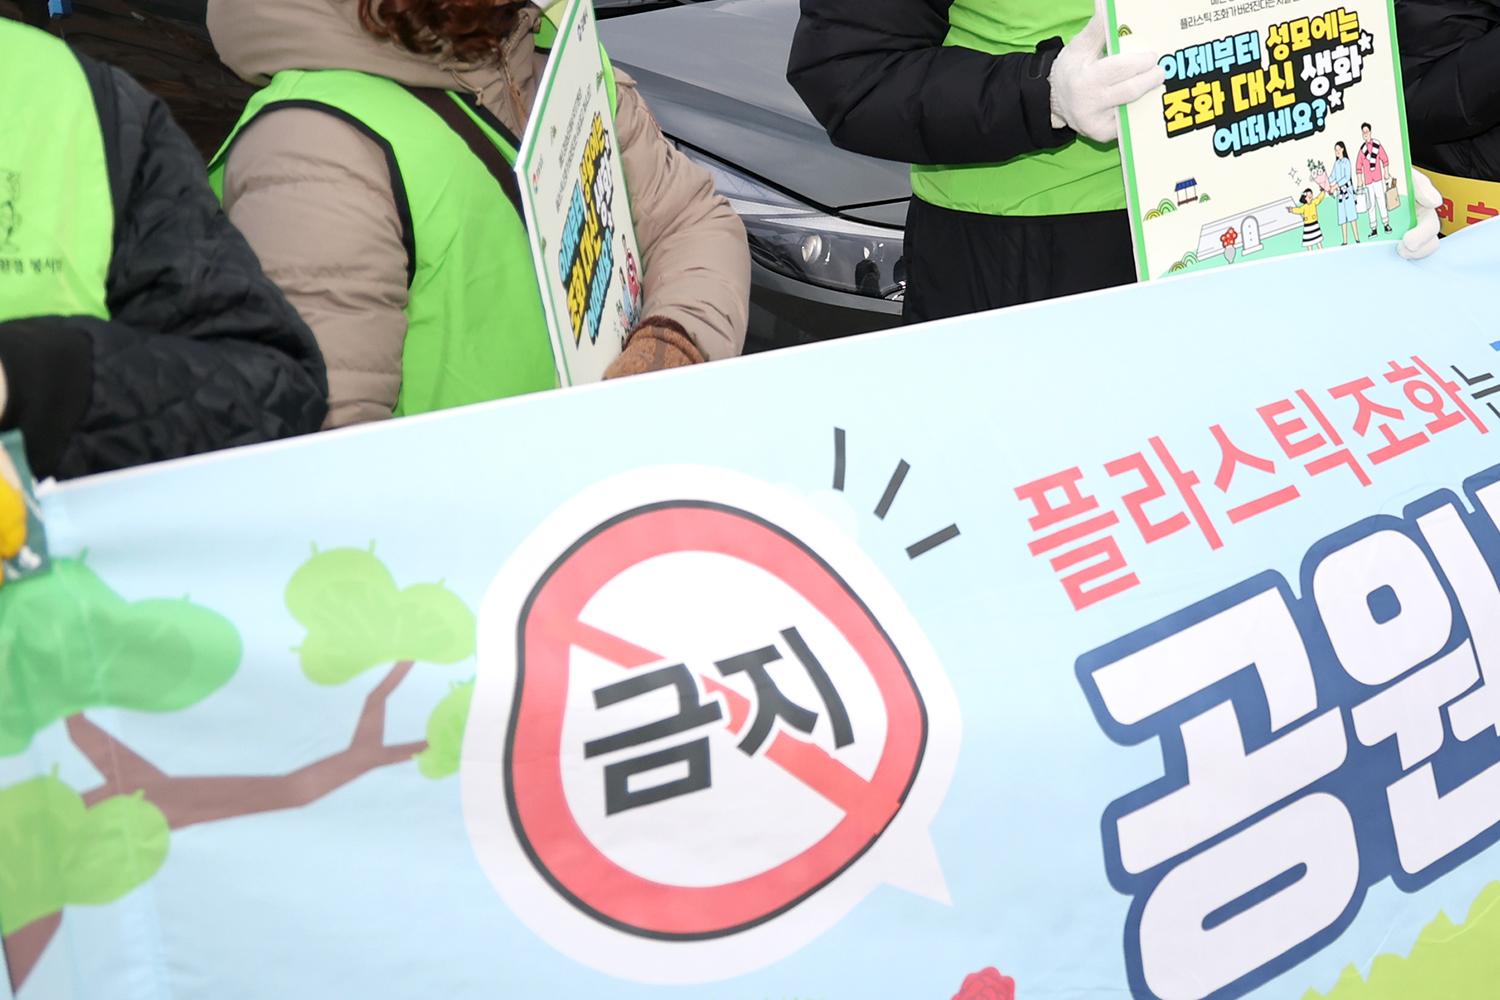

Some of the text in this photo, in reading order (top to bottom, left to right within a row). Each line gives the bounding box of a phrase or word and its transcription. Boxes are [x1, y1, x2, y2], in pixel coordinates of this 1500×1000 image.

[1157, 6, 1361, 82] 이제부터 성묘에는
[1179, 11, 1213, 30] 플라스틱
[1213, 4, 1237, 22] 조화가
[1162, 42, 1364, 136] 조화 대신 생화
[1212, 97, 1329, 154] 어떠세요?
[558, 178, 585, 285] 이제부터
[580, 112, 606, 205] 성묘에는
[566, 256, 587, 344] 조화
[580, 199, 602, 286] 대신
[583, 625, 855, 818] 금지
